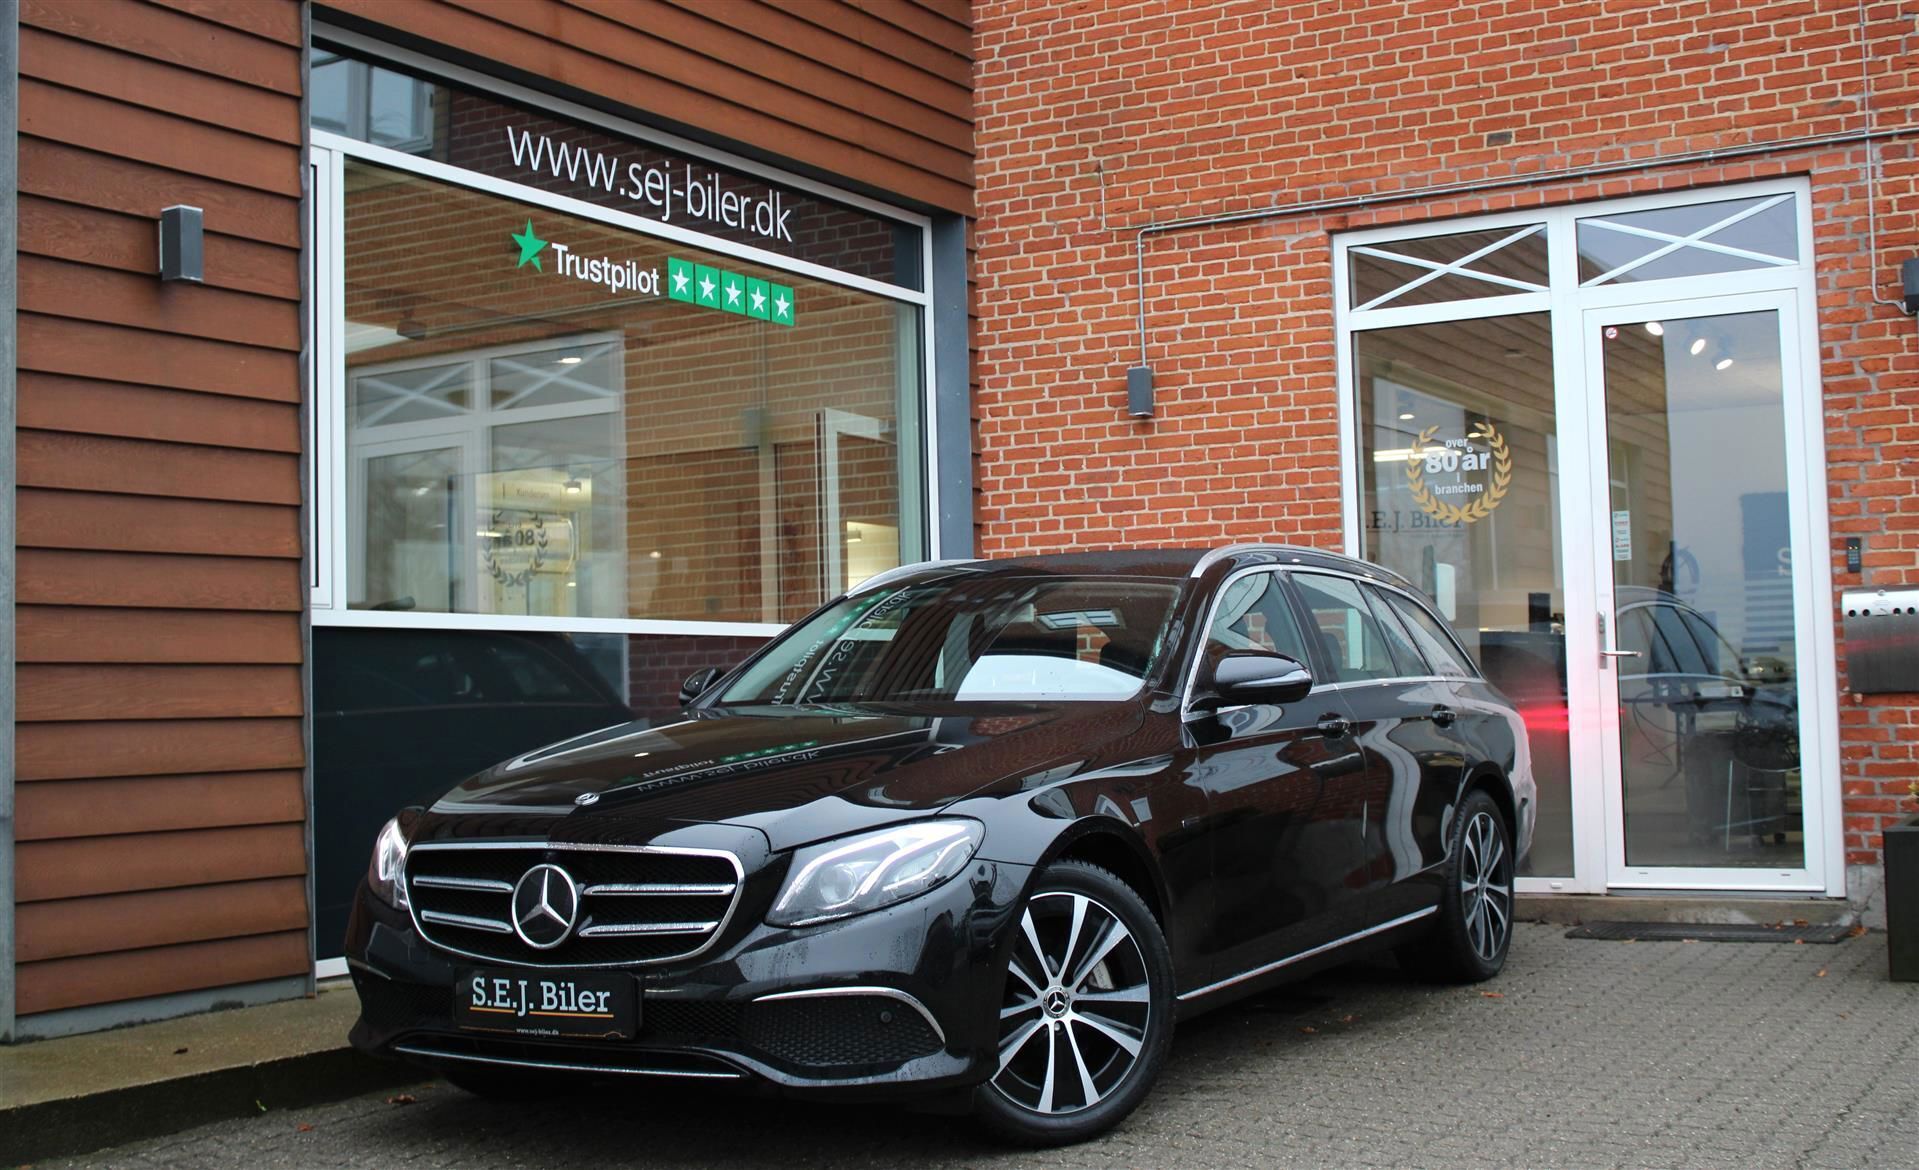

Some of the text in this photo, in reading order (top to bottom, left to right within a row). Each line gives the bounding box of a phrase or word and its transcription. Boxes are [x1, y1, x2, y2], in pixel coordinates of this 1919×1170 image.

[507, 125, 793, 242] www.sej-biler.dk
[551, 242, 661, 297] Trustpilot
[1425, 446, 1491, 474] 80 år
[1445, 438, 1469, 448] over
[1434, 482, 1483, 495] branchen
[472, 977, 610, 1017] S.E.J. Biler
